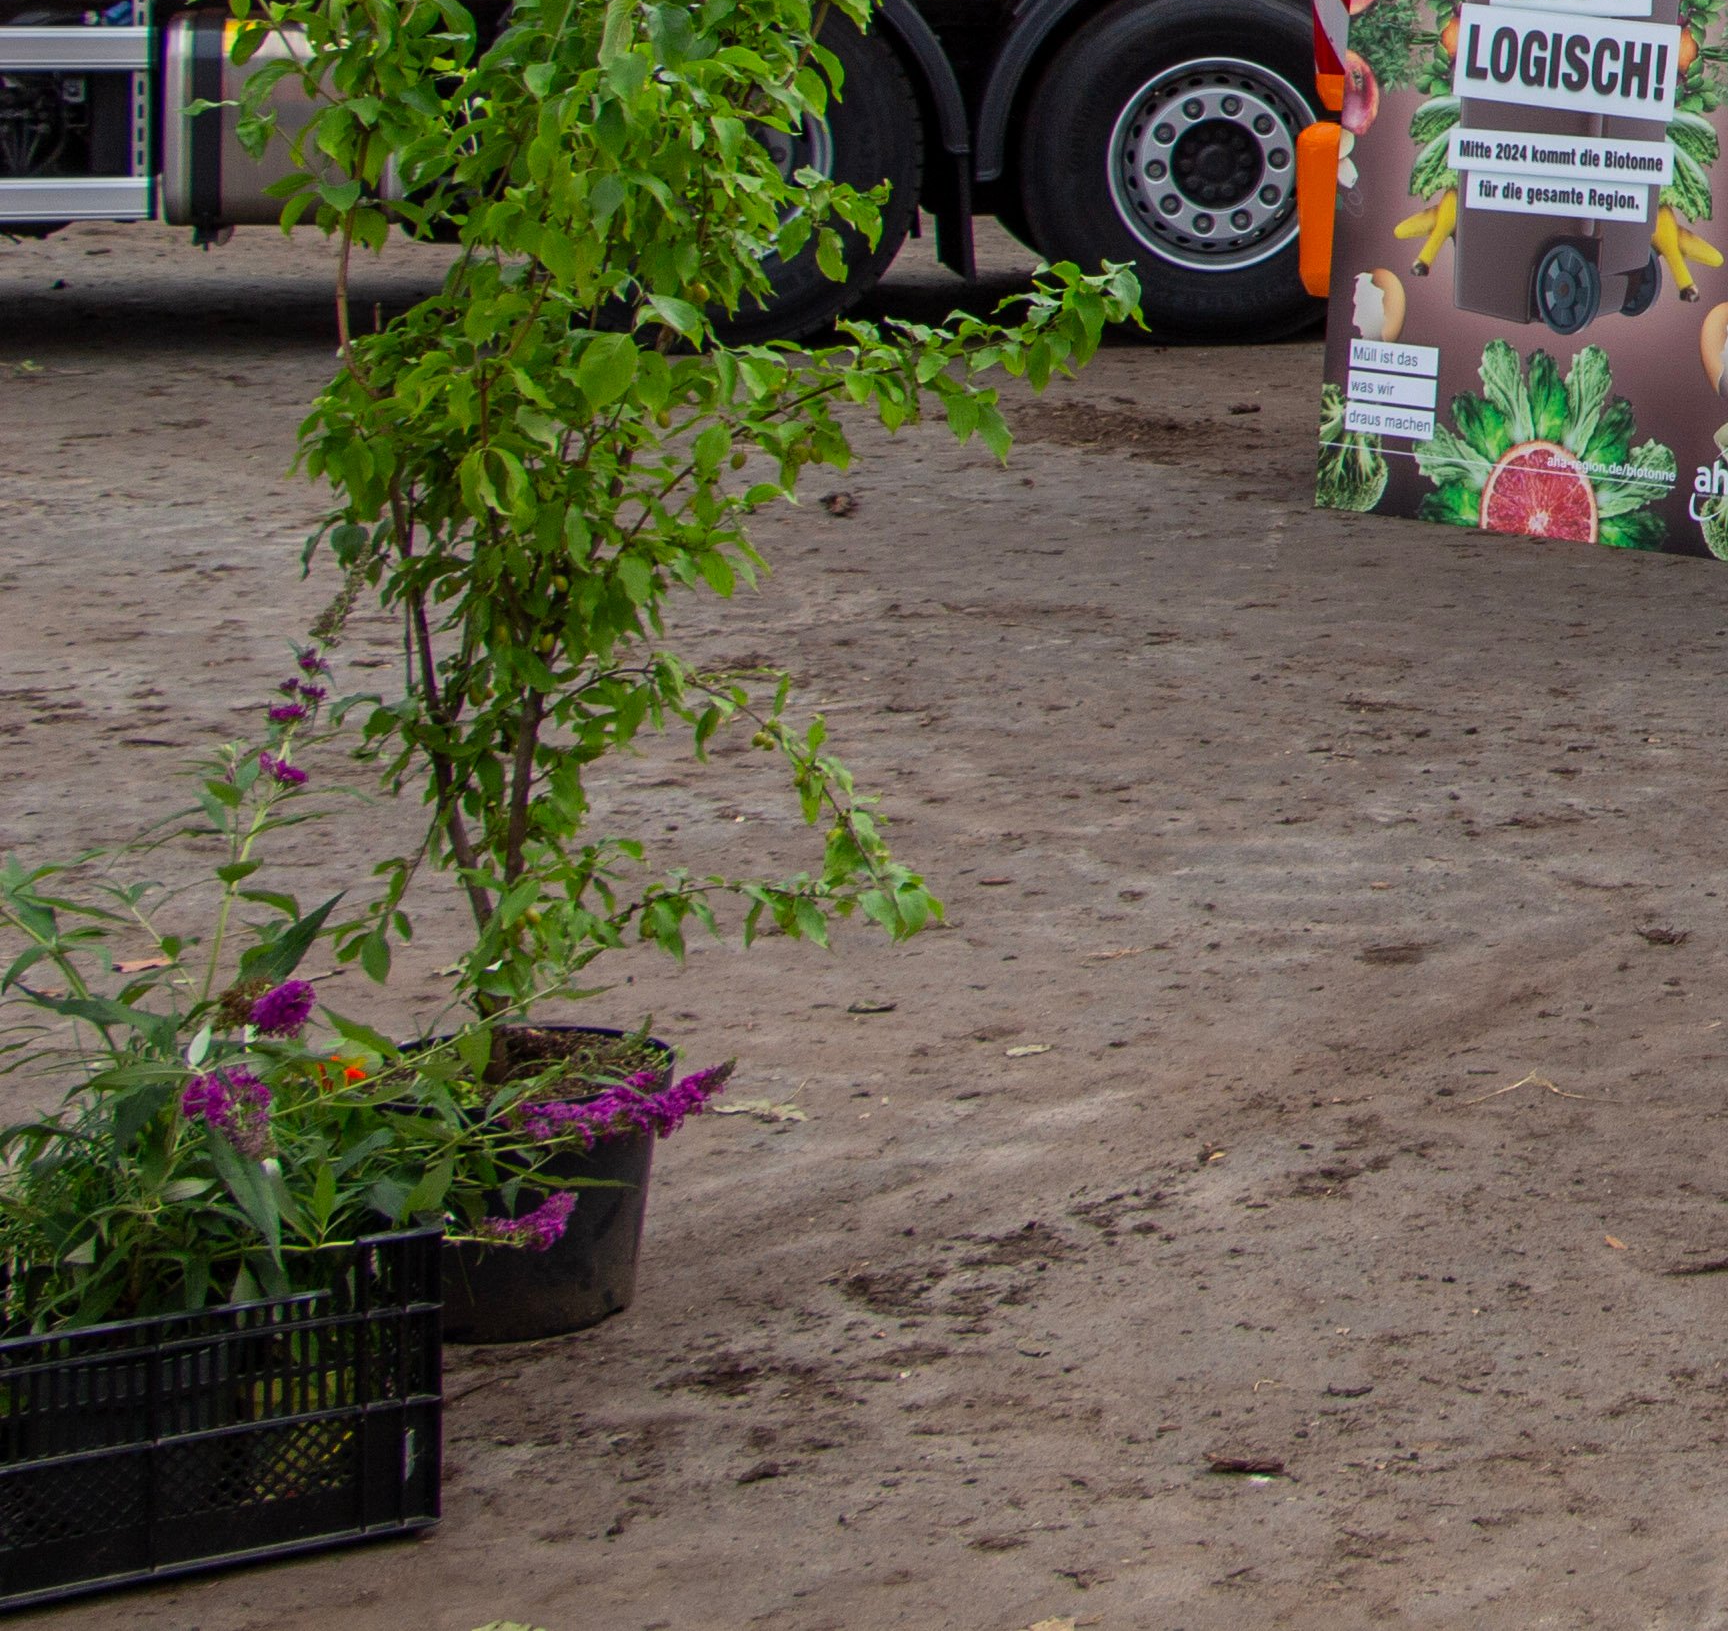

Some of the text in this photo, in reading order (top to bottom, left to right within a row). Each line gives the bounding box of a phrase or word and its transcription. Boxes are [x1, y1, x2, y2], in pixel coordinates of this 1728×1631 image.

[1465, 24, 1668, 100] LOGISCH!
[1459, 139, 1664, 171] Mitte 2024 kommt die Biotonne
[1479, 180, 1640, 211] für die gesamte Region.
[1353, 346, 1418, 367] Müll ist das
[1350, 379, 1395, 396] was wir
[1348, 409, 1431, 433] draus machen
[1547, 455, 1676, 482] aha-region.de/biotonne
